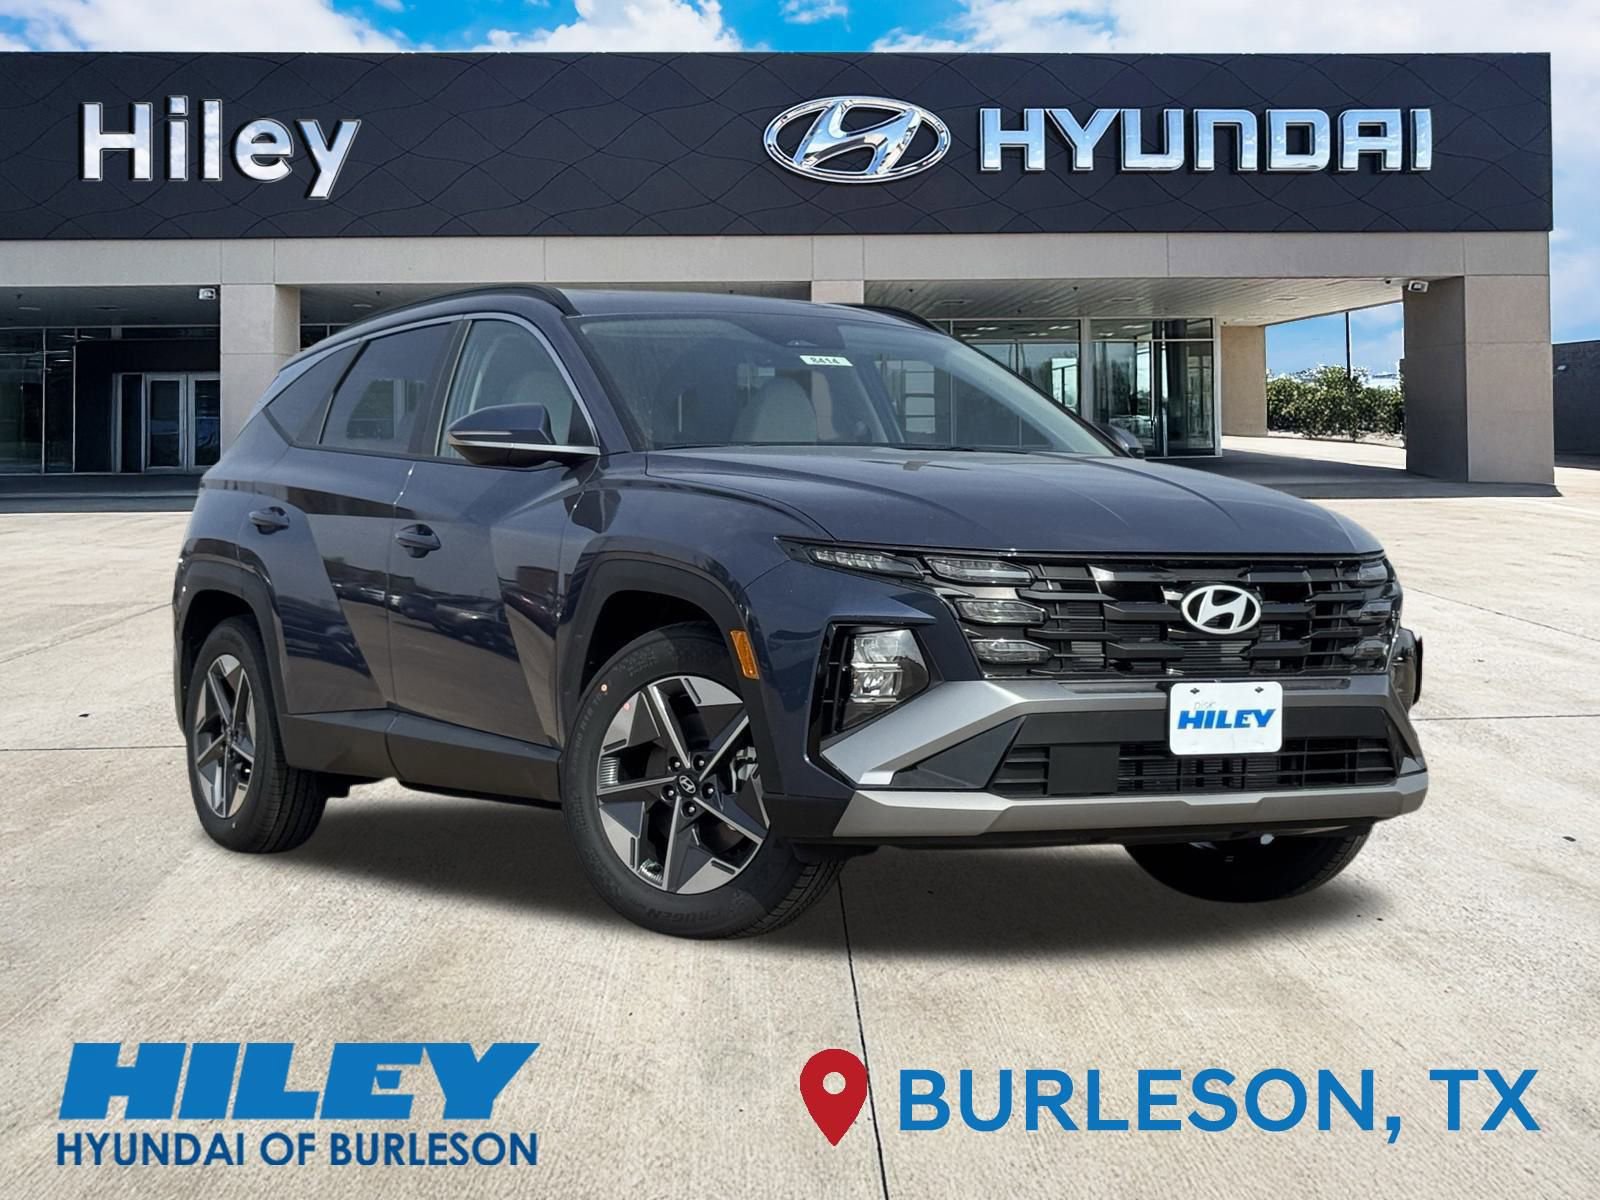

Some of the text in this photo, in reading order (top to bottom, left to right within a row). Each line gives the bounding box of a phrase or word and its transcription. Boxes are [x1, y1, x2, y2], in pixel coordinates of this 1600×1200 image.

[80, 95, 362, 200] Hiley
[979, 107, 1433, 173] HYUNDAI
[1177, 710, 1276, 730] HILEY
